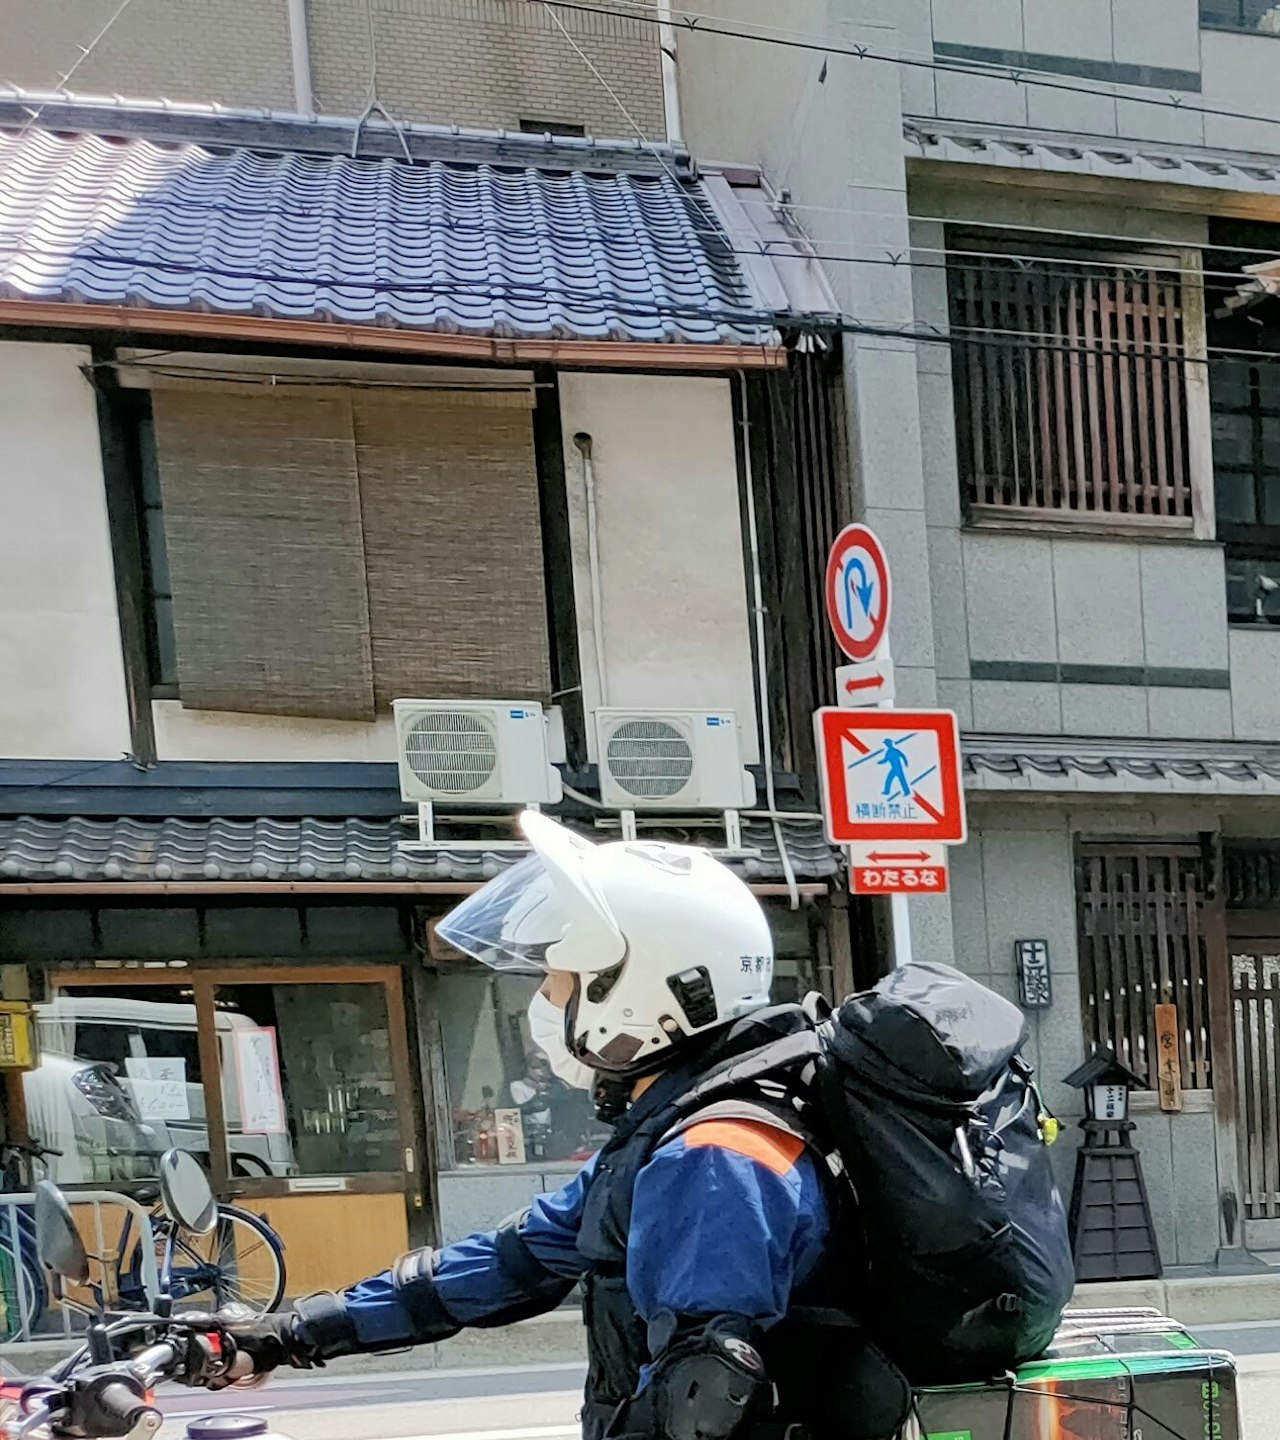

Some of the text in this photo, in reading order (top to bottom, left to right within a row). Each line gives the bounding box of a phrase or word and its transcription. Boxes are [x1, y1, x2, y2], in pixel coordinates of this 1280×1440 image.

[855, 802, 918, 820] 横断禁止
[862, 869, 939, 887] わたるな
